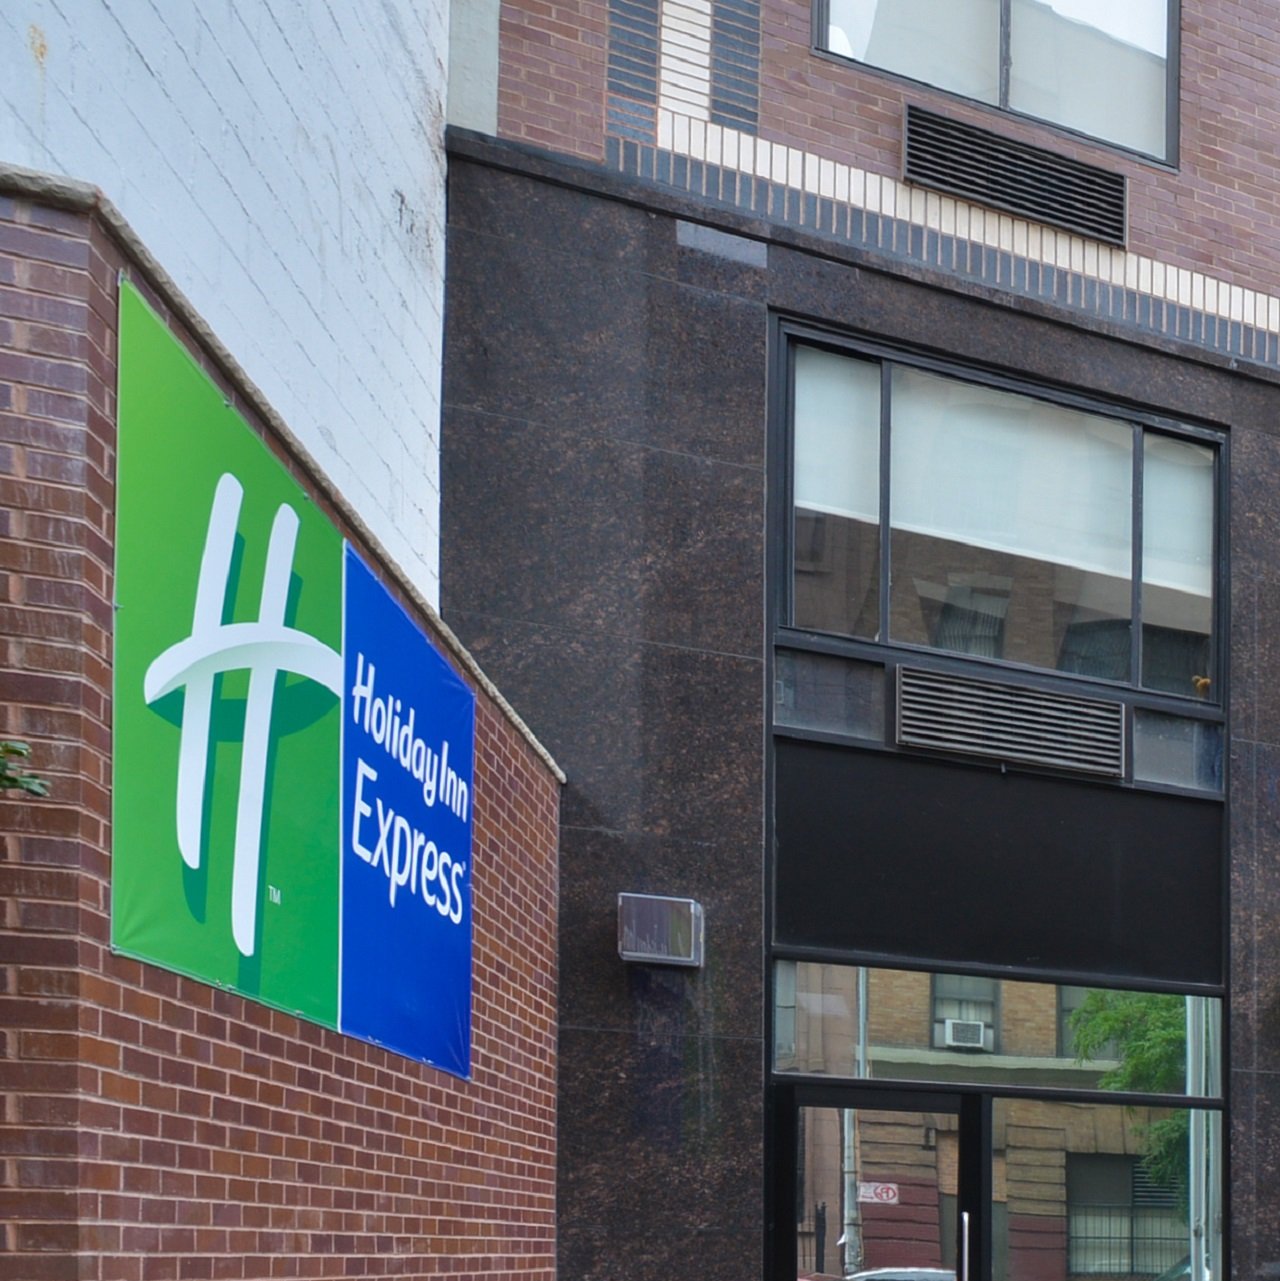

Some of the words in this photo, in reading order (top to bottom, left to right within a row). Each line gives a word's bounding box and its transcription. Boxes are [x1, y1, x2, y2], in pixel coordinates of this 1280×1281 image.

[351, 651, 439, 808] Holiday
[439, 740, 469, 824] Inn
[351, 757, 465, 925] Express
